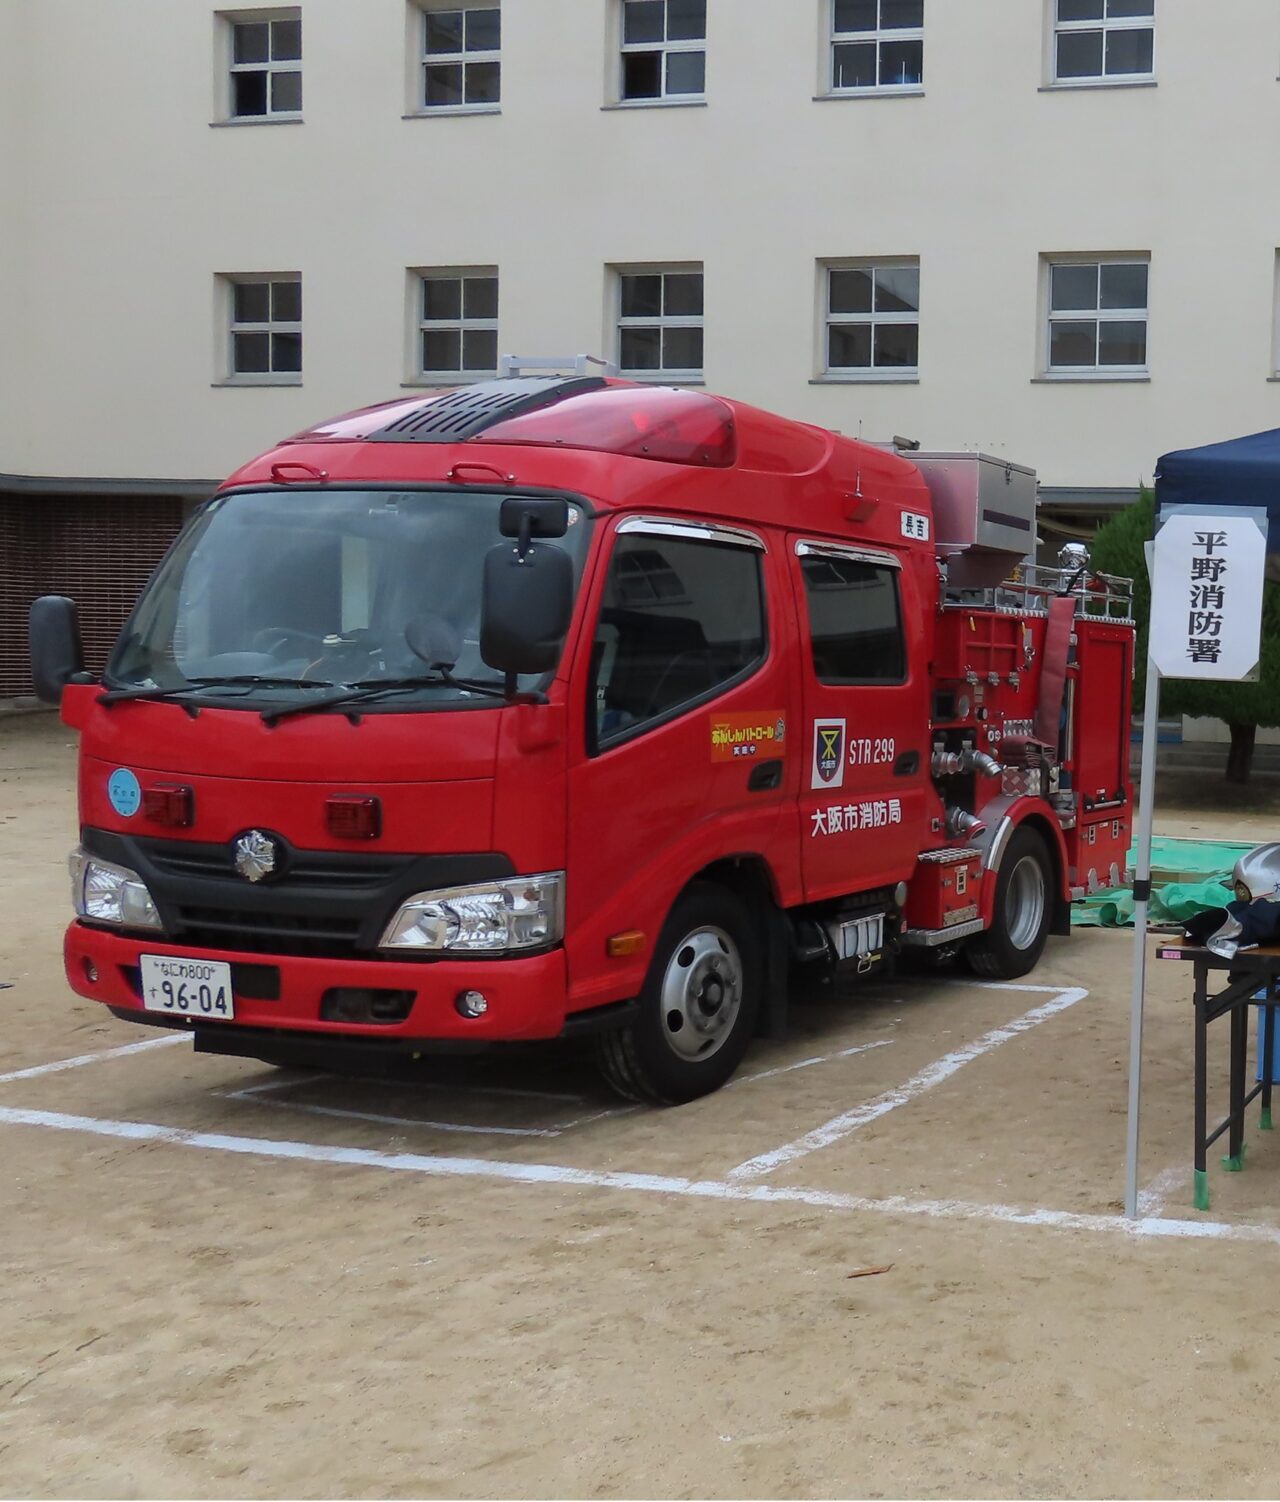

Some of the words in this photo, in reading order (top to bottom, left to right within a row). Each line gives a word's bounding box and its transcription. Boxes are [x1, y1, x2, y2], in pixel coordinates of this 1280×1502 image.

[905, 515, 925, 537] 長吉
[1185, 530, 1229, 664] 平野消防署
[849, 739, 872, 765] STR
[873, 737, 895, 764] 299
[810, 798, 902, 838] 大阪市消防局
[161, 980, 228, 1015] 96-04
